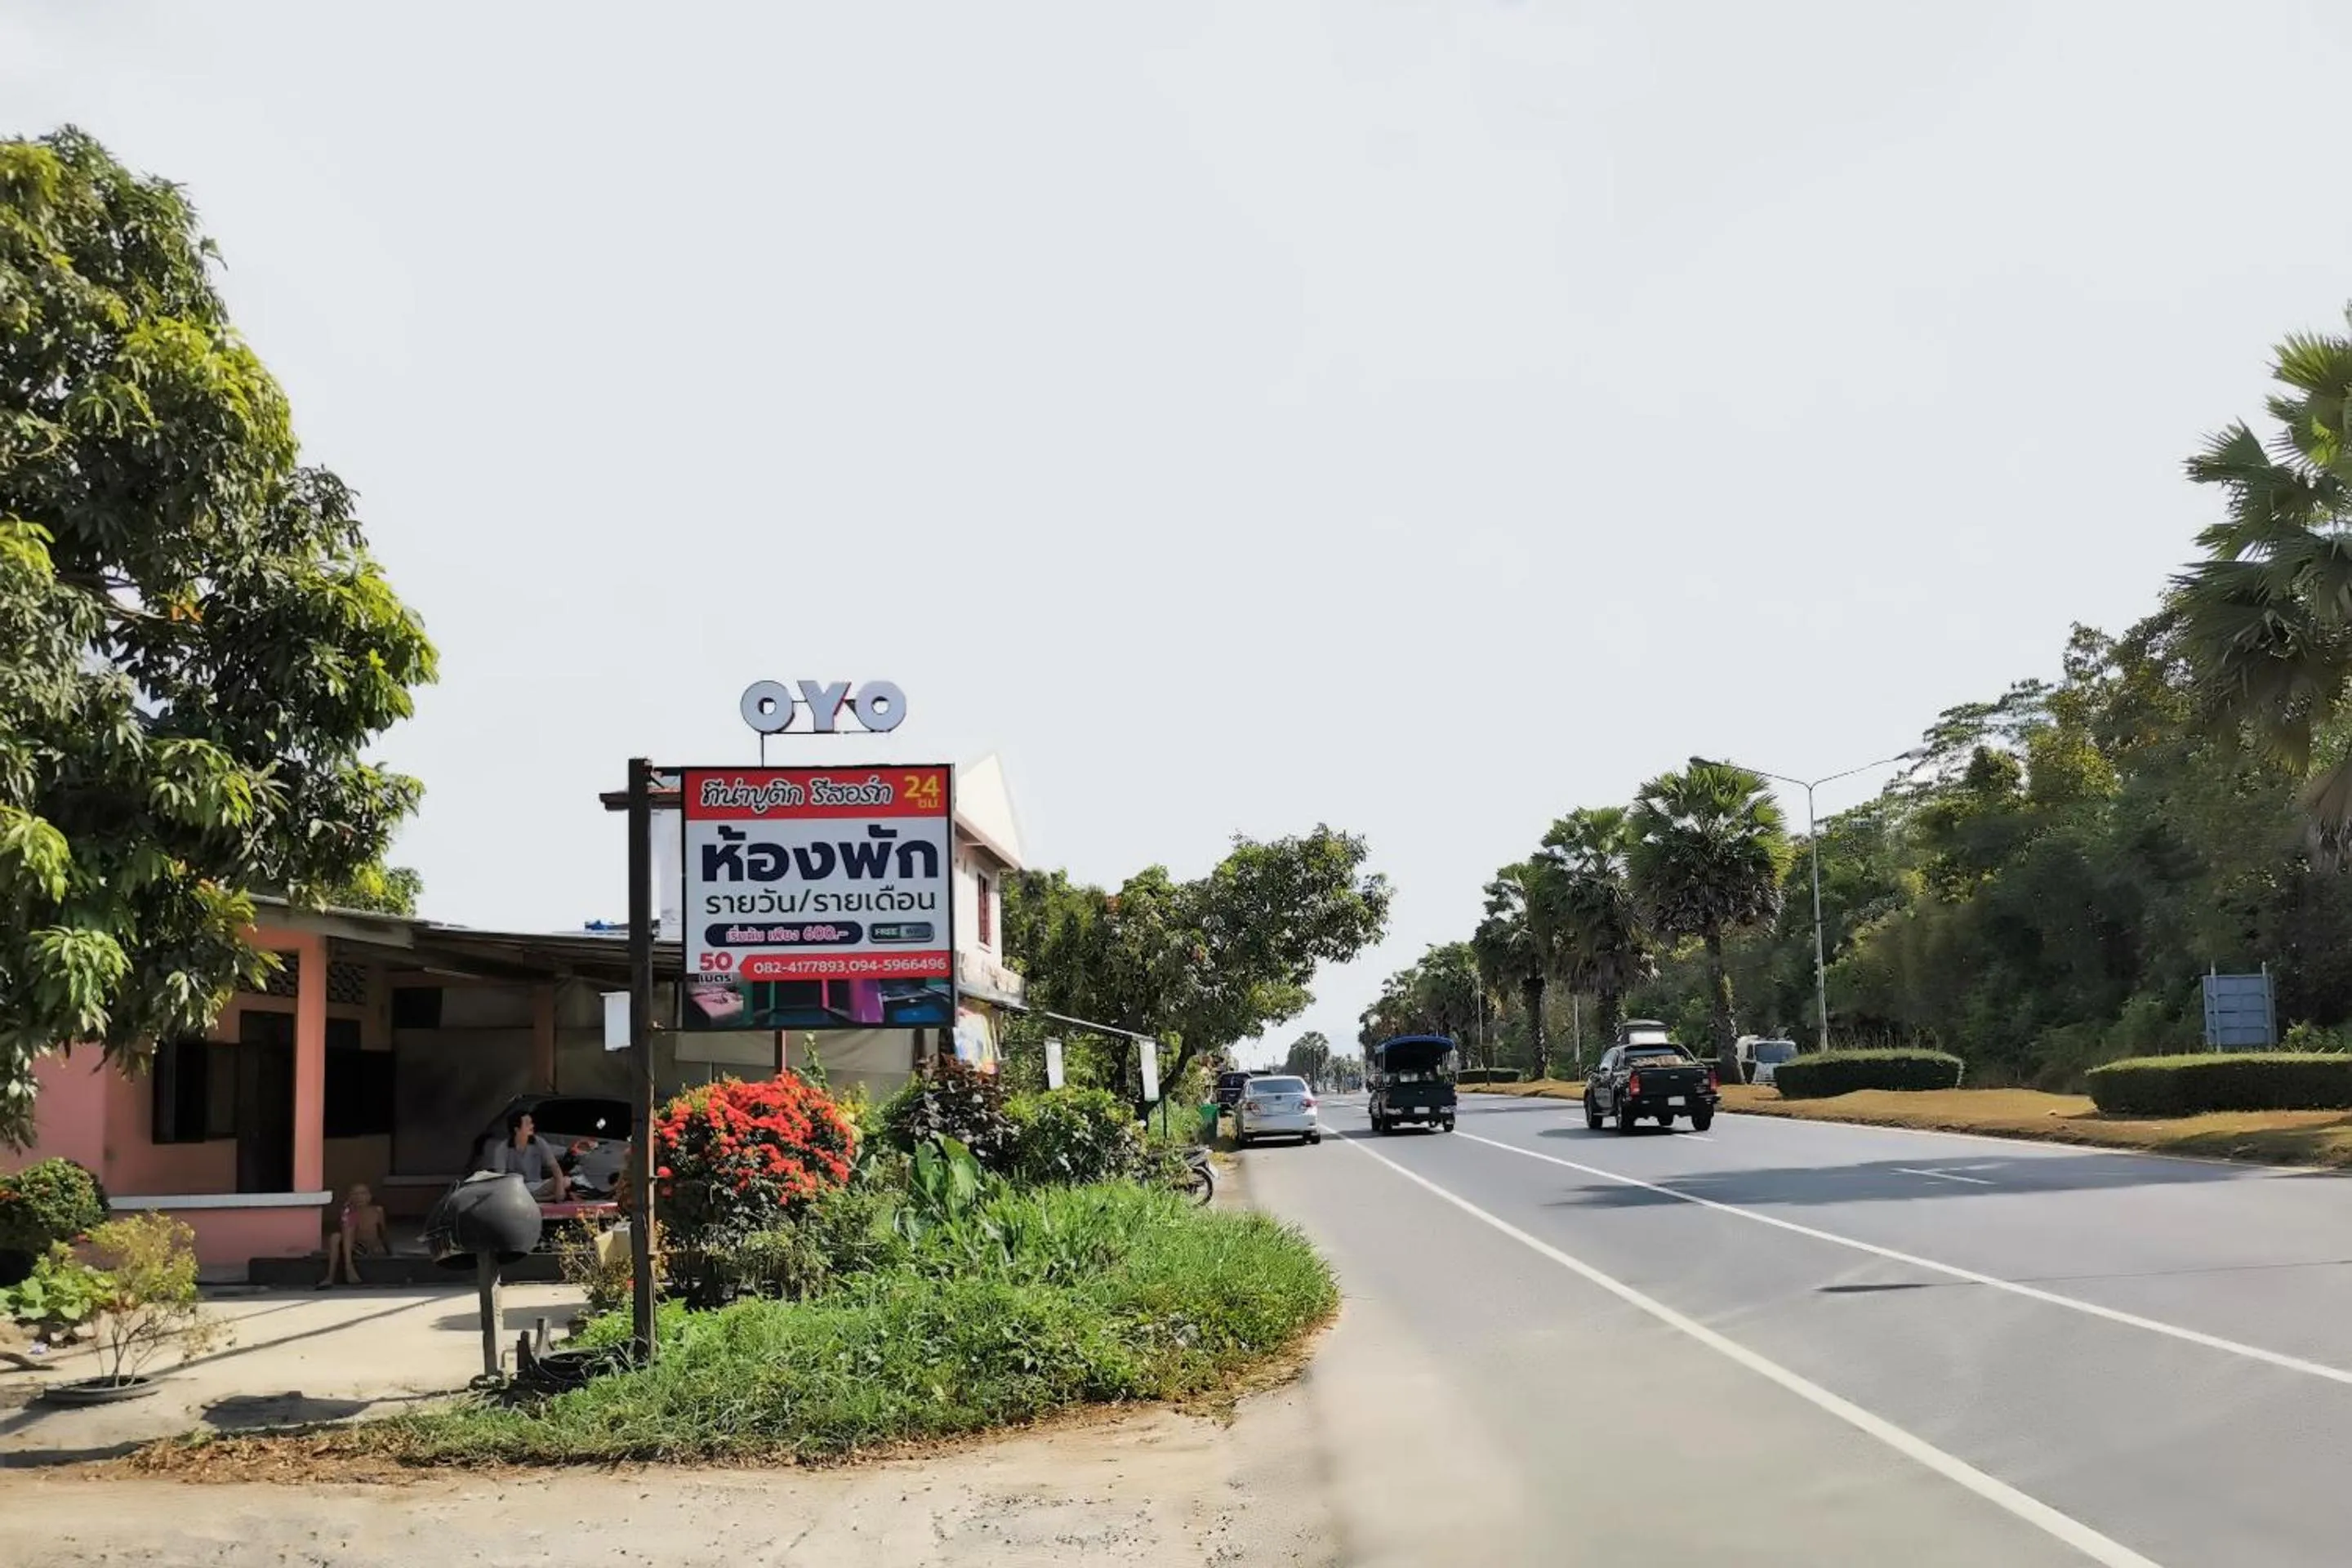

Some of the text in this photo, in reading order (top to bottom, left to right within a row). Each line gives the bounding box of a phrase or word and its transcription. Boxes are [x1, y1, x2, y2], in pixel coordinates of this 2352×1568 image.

[740, 679, 906, 733] OYO
[810, 775, 893, 805] รีสอร์ท
[904, 775, 941, 798] 24
[702, 824, 938, 882] ห้องพัก
[706, 884, 937, 915] รายวัน/รายเดือน
[700, 951, 733, 971] 50
[699, 973, 733, 983] เมตร
